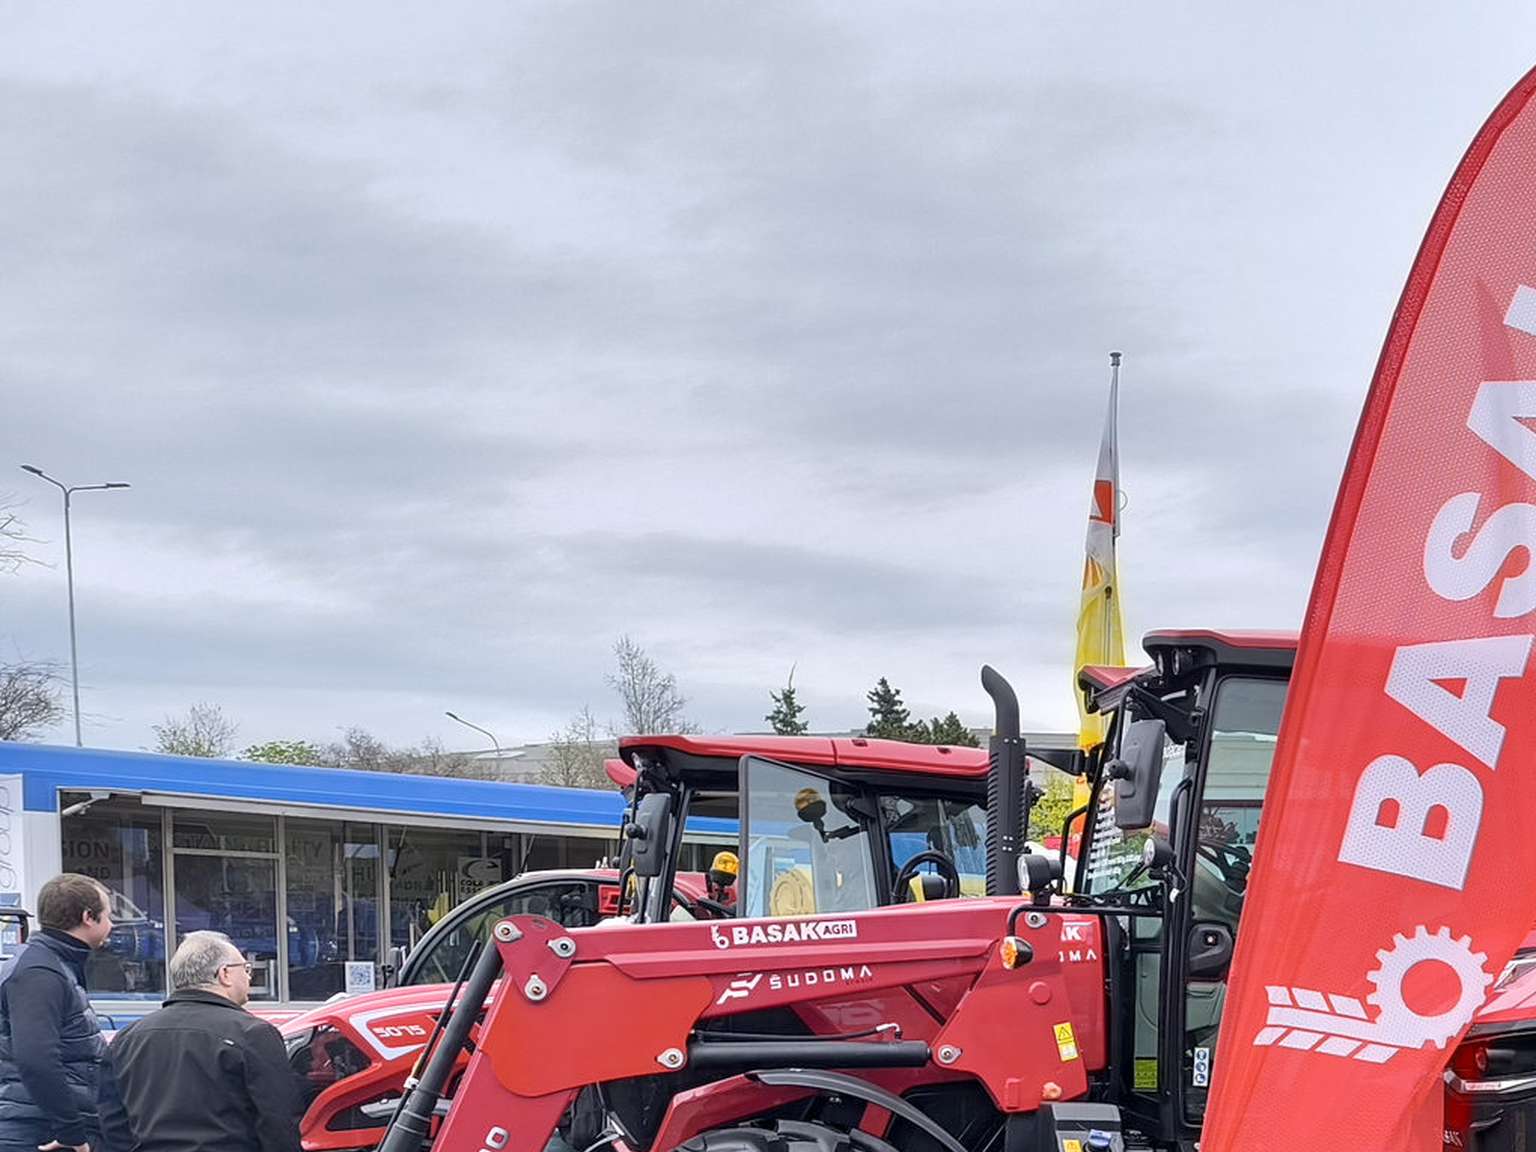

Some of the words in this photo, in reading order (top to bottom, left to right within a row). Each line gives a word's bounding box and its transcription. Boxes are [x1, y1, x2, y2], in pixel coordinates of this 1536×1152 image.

[733, 921, 820, 946] BASAK
[821, 923, 856, 939] AGRI
[372, 1024, 427, 1038] 5075
